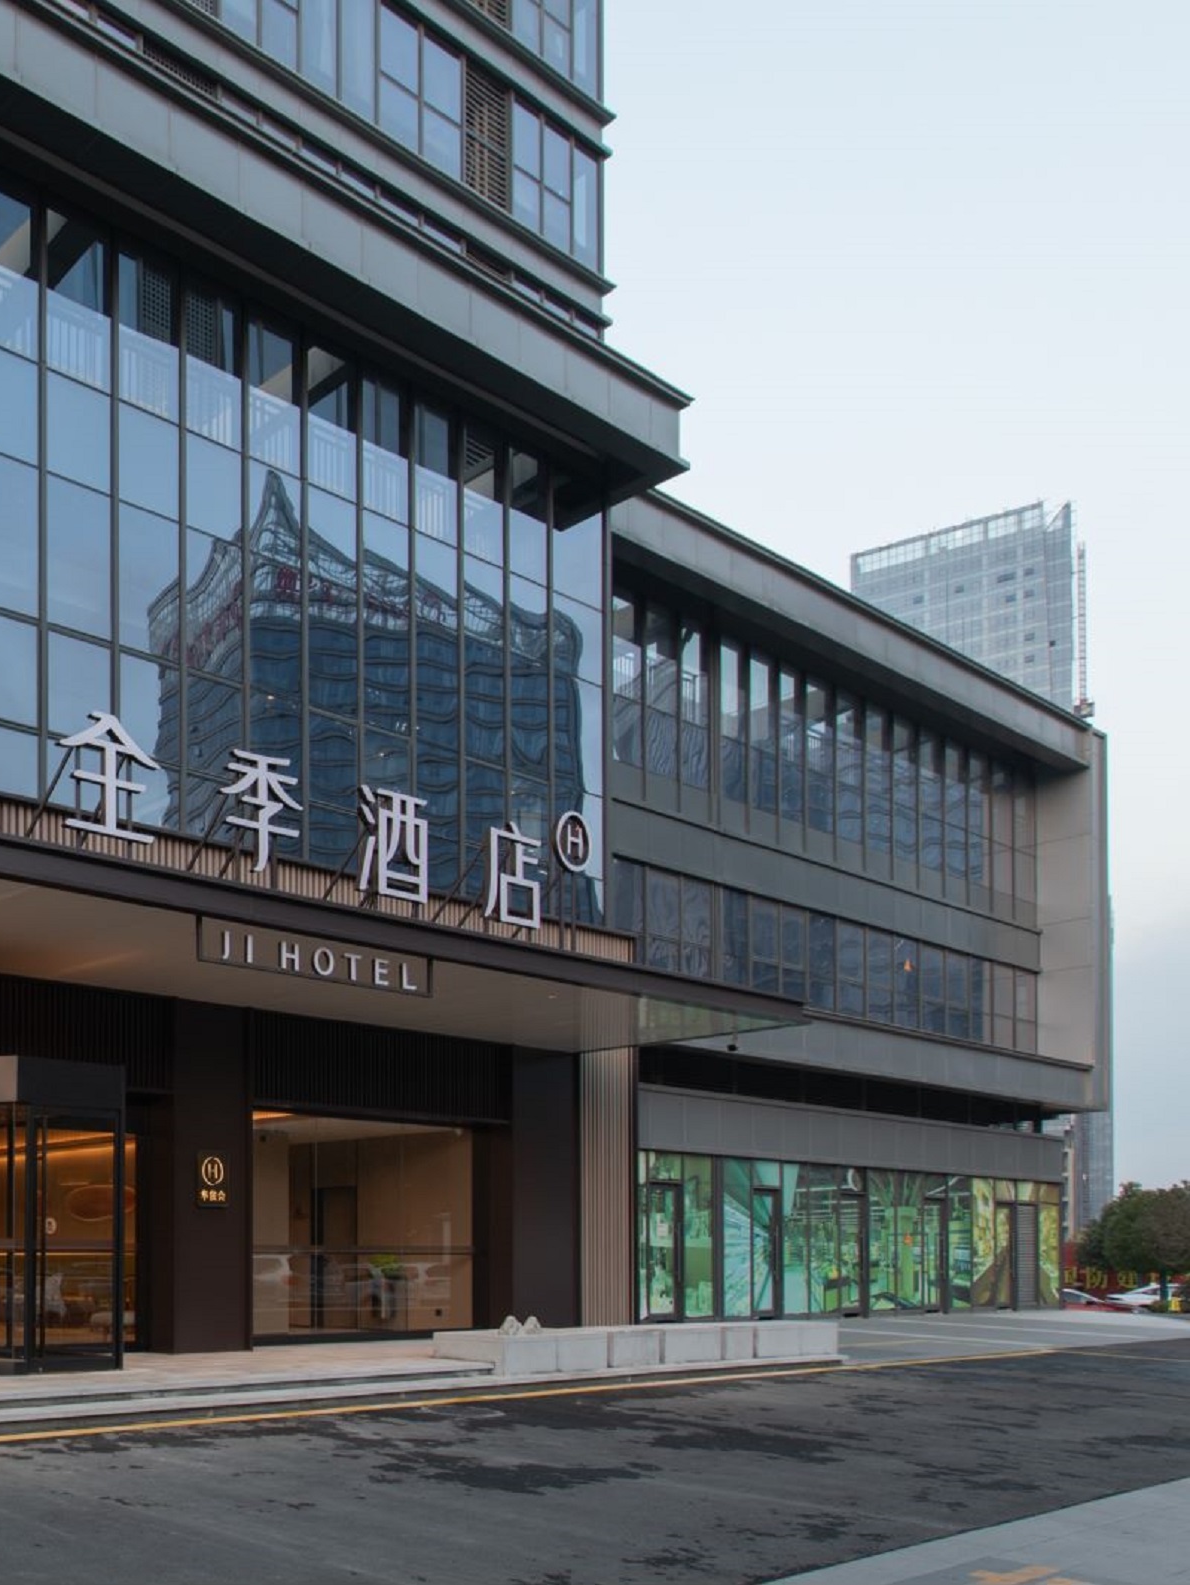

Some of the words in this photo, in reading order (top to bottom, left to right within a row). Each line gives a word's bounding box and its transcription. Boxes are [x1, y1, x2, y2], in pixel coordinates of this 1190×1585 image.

[59, 710, 541, 930] 全季酒店
[222, 930, 253, 964] JI
[279, 940, 418, 990] HOTEL
